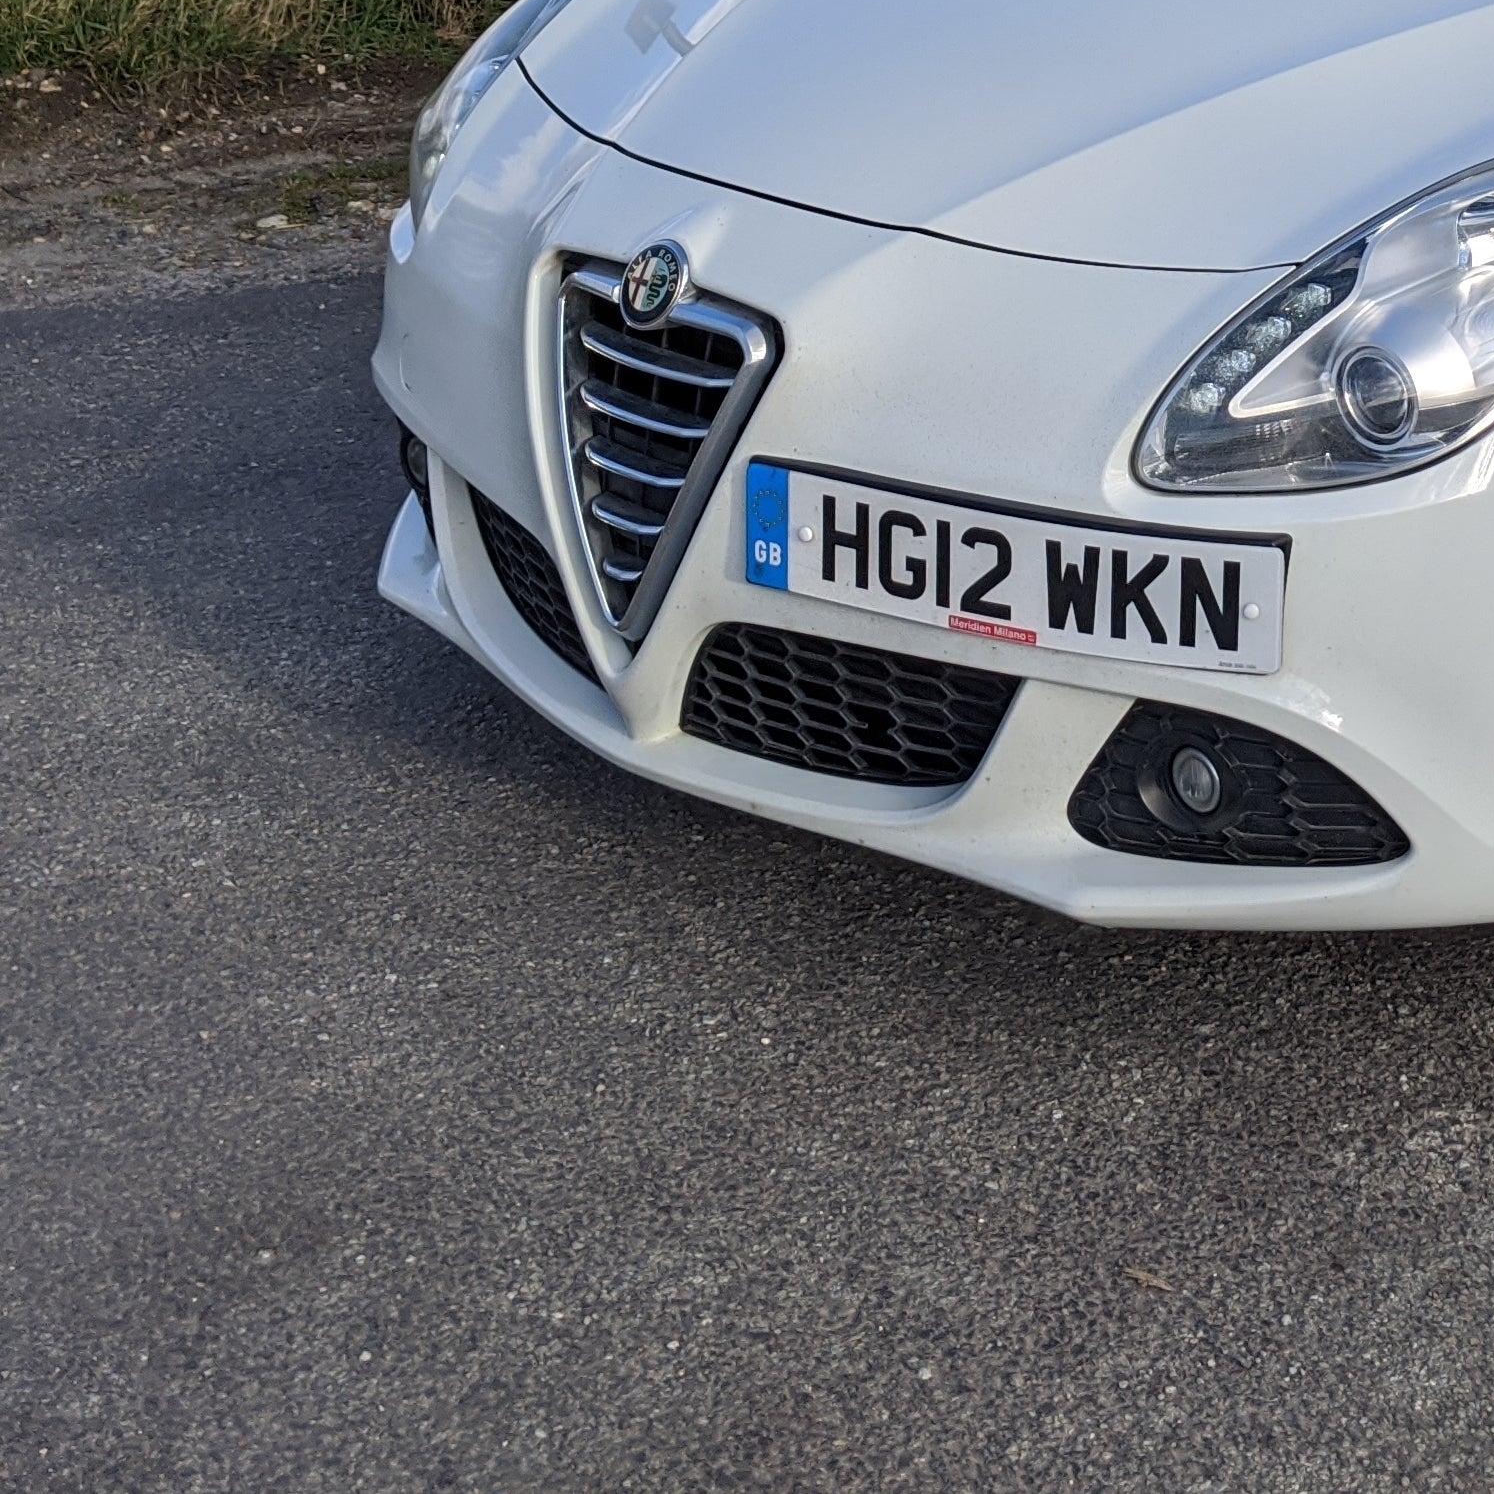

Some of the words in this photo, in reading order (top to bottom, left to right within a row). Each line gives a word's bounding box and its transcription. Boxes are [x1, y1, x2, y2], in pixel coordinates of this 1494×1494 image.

[627, 250, 652, 281] ALFA
[658, 249, 678, 291] ROMEO
[755, 540, 782, 566] GB
[822, 494, 1012, 621] HG12
[1045, 539, 1241, 651] WKN
[950, 616, 992, 634] Meridien
[993, 625, 1026, 641] Milano
